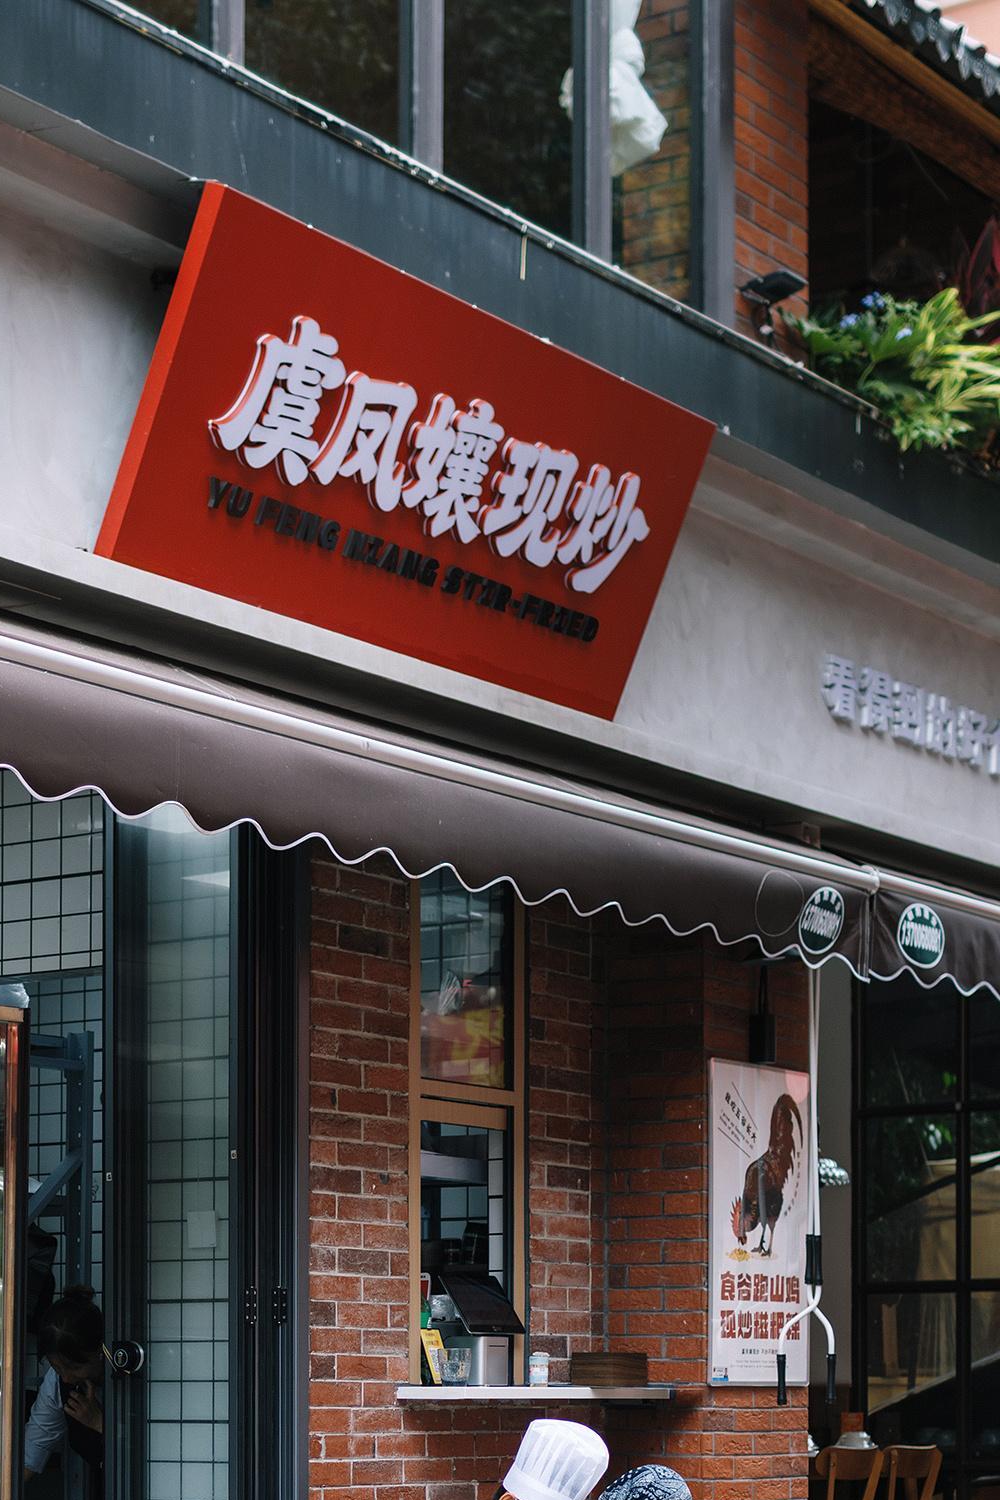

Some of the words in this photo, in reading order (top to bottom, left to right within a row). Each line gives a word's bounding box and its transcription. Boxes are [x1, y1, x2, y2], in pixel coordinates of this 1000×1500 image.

[207, 476, 253, 518] YU
[254, 496, 340, 551] FENG
[342, 528, 440, 588] NIANG
[441, 564, 599, 643] STIR-FRIED
[721, 1271, 800, 1304] 食谷跑山鸡
